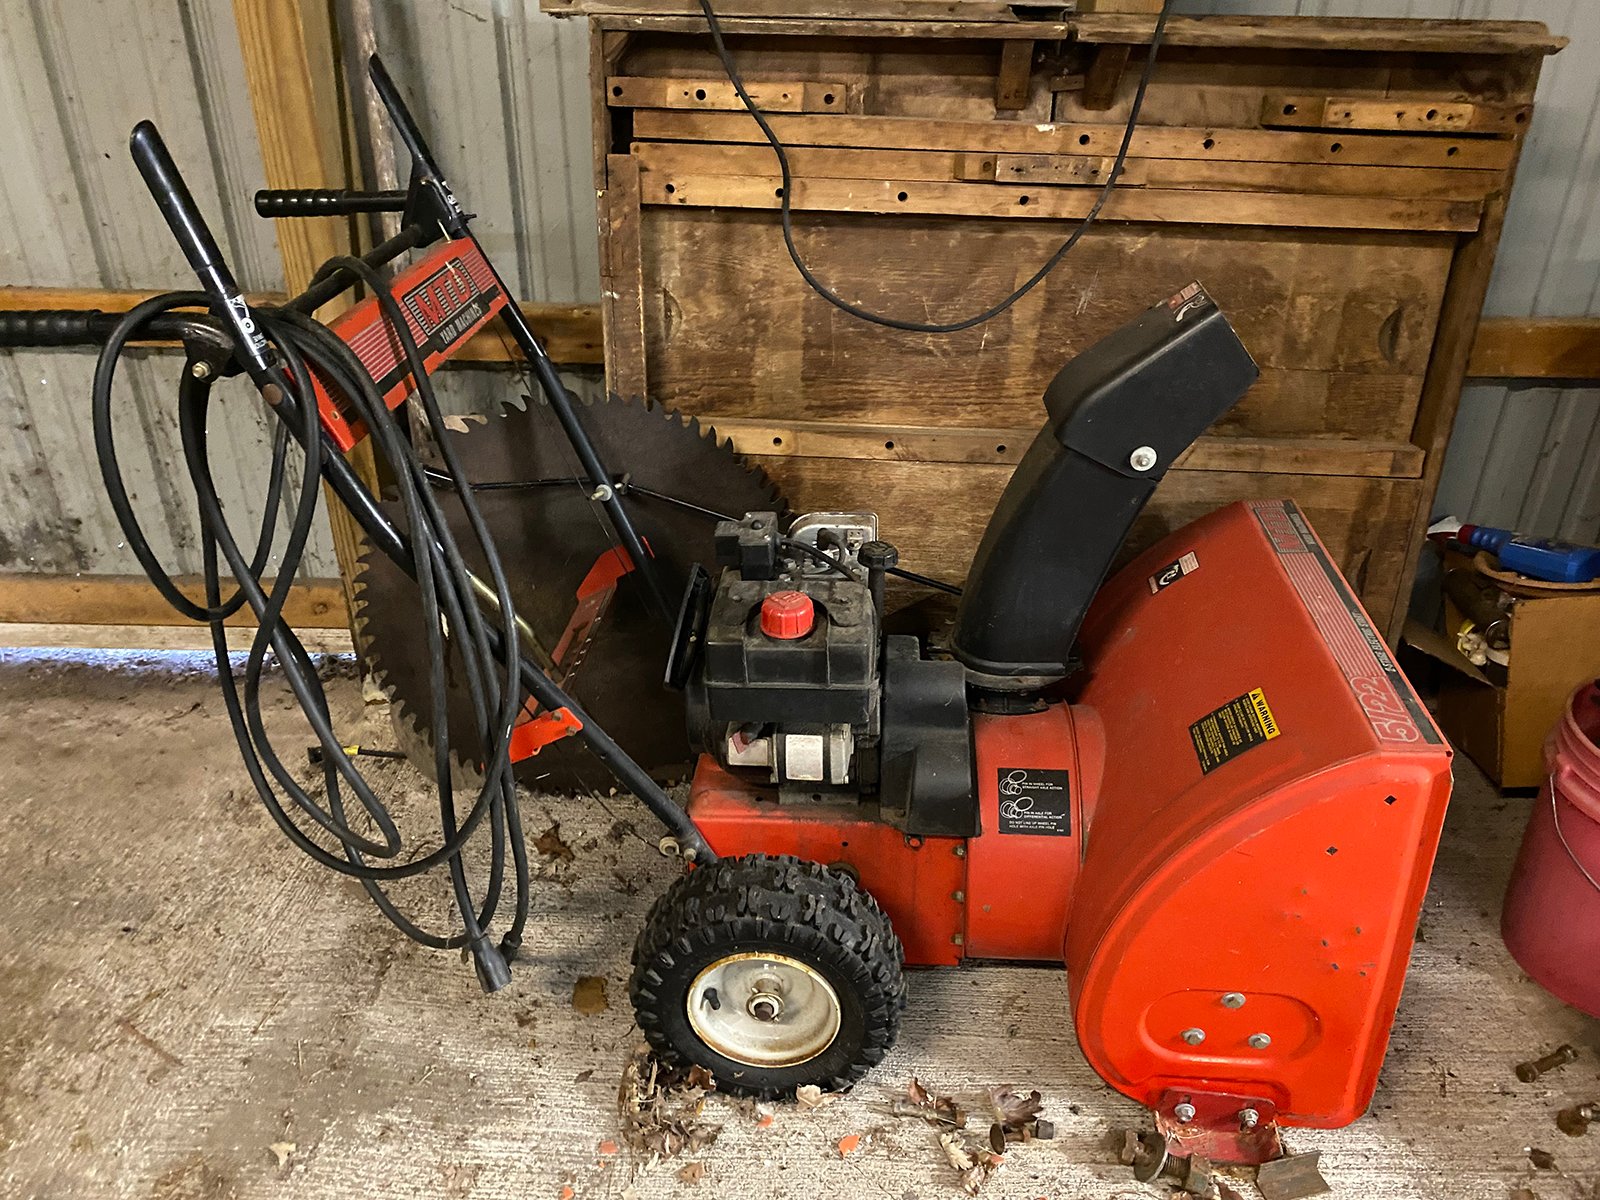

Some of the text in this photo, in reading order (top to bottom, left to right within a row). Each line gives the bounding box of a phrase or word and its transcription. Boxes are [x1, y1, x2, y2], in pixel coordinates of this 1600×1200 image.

[414, 267, 472, 329] MTD
[440, 324, 457, 344] YARD
[1256, 700, 1275, 735] WARNING
[1350, 676, 1418, 742] 5/22
